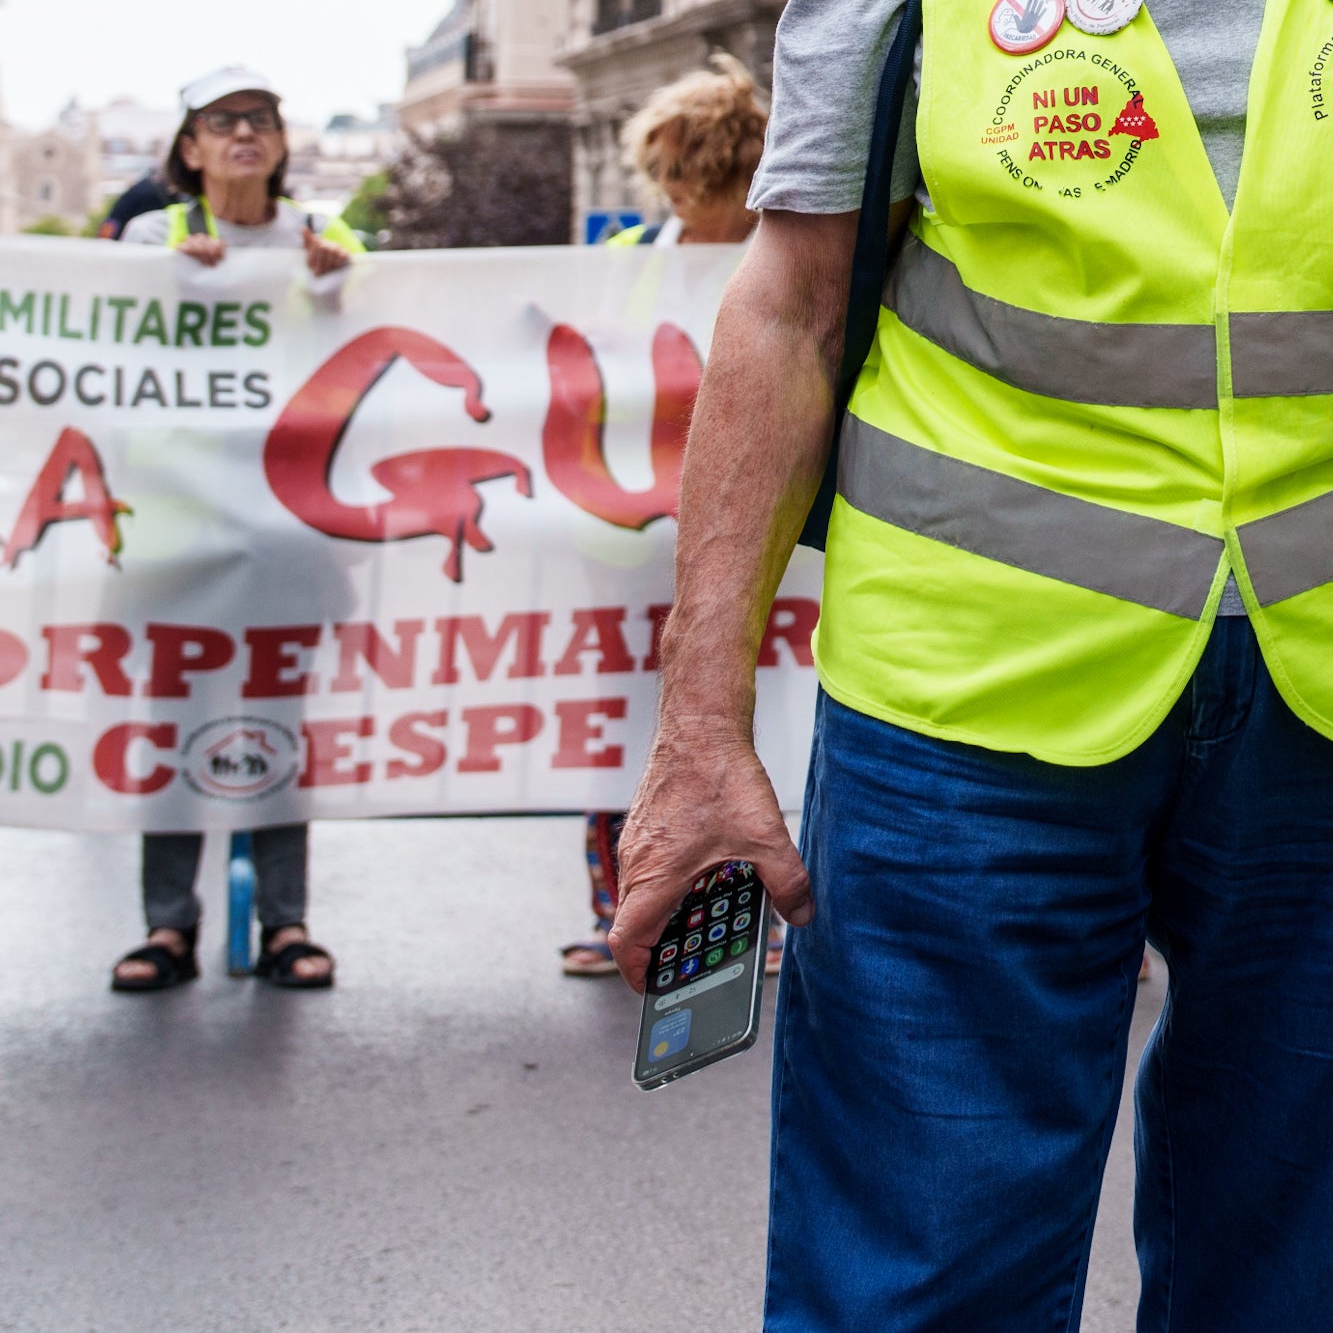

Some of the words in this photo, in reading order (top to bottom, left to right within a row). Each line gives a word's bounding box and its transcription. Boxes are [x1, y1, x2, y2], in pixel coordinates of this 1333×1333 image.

[992, 49, 1087, 126] COORDINADORA
[1091, 53, 1144, 109] GENERAL
[1032, 89, 1056, 110] NI
[1063, 85, 1099, 107] UN
[986, 122, 1016, 136] CGPM
[1033, 112, 1102, 134] PASO
[980, 131, 1020, 146] UNIDAD
[1028, 138, 1112, 162] ATRAS
[1104, 138, 1143, 186] MADRID
[0, 288, 272, 348] MILITARES
[0, 739, 69, 795] IO
